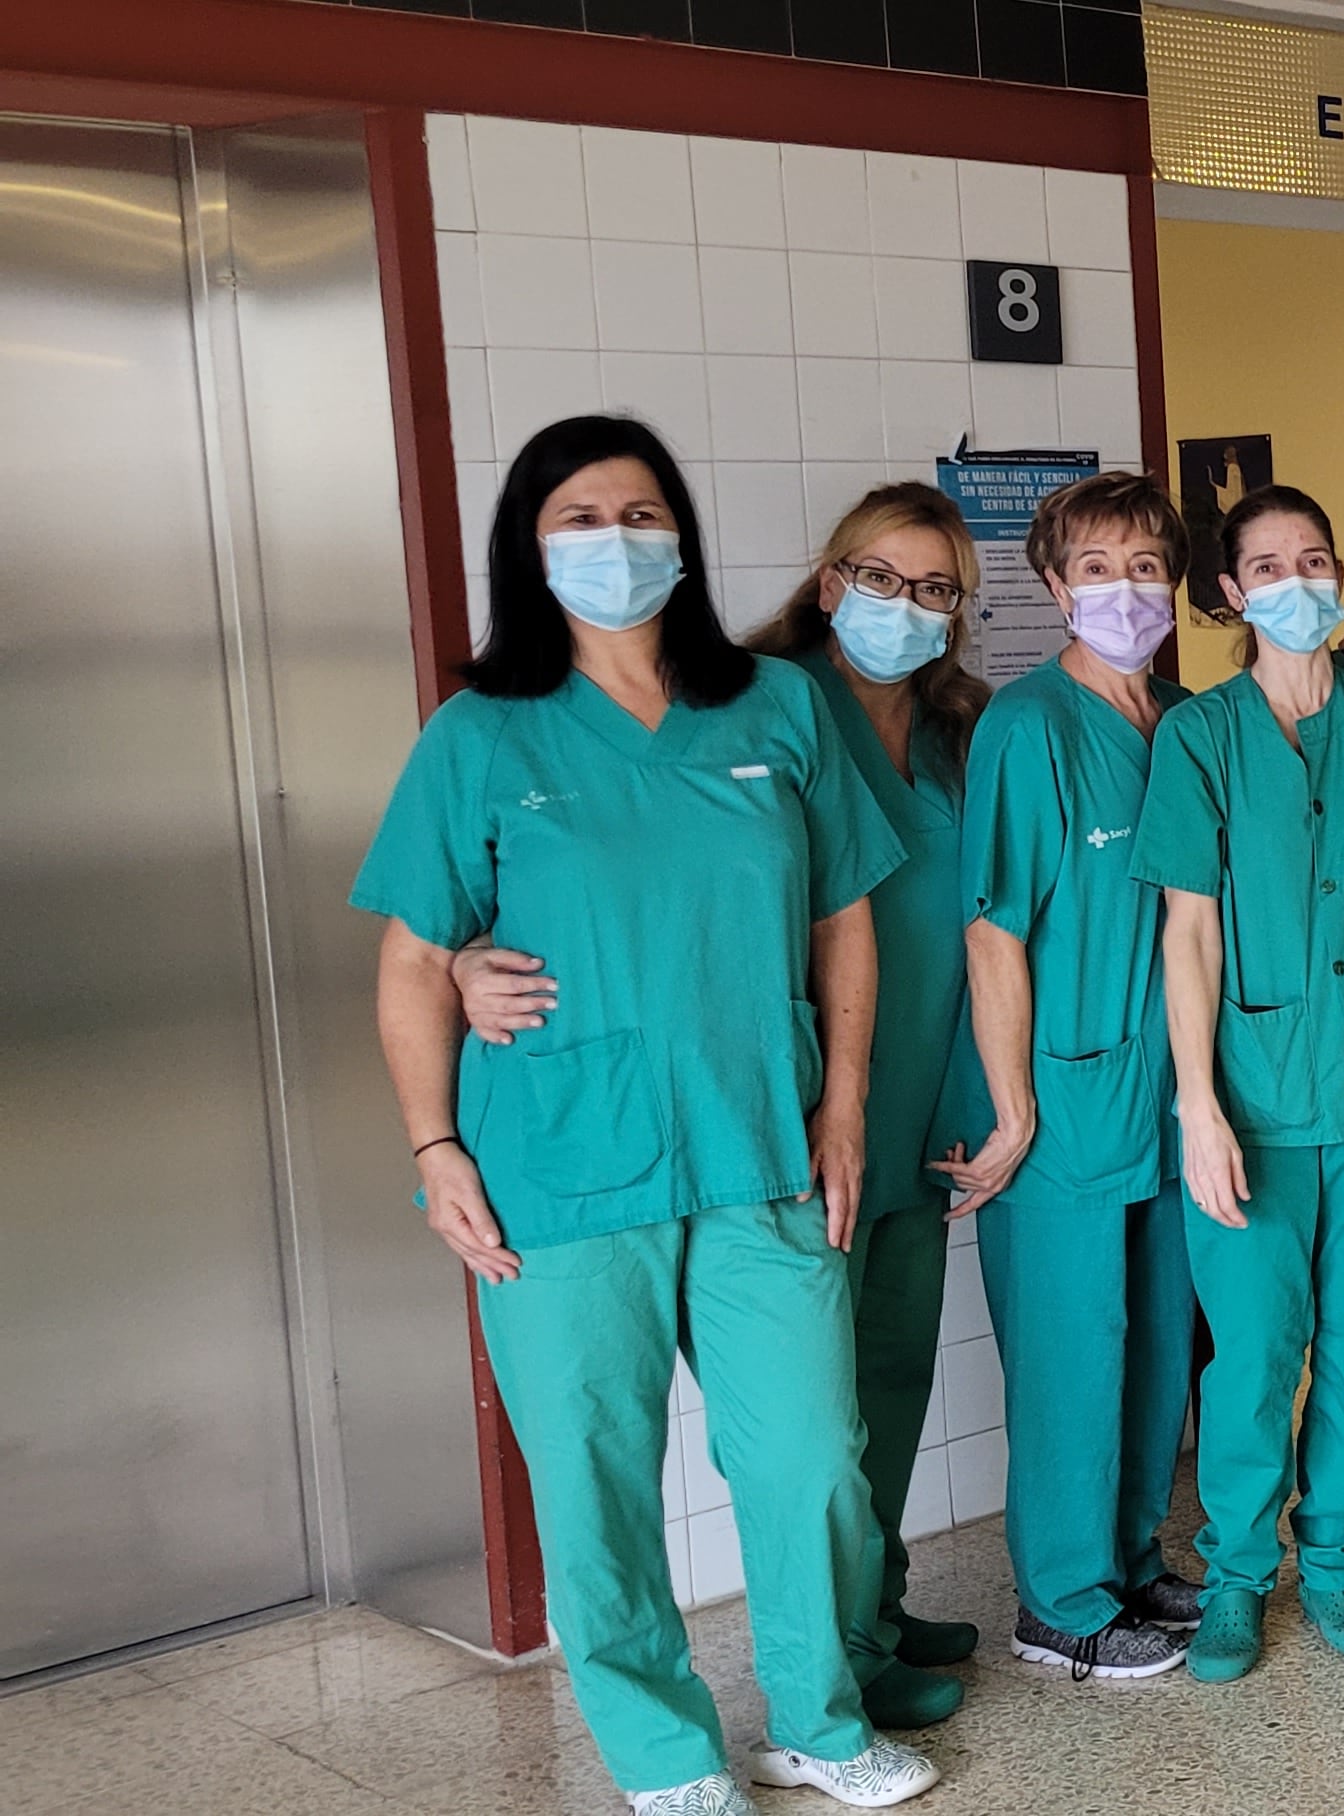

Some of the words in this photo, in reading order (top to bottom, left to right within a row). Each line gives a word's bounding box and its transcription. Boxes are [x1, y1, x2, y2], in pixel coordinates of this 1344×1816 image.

[998, 268, 1041, 333] 8
[957, 471, 969, 483] DE
[972, 471, 1007, 483] MANERA
[1033, 472, 1041, 483] Y
[960, 485, 975, 497] SIN
[977, 485, 1022, 497] NECESIDAD
[1024, 485, 1035, 497] DE
[982, 499, 1014, 511] CENTRO
[1015, 500, 1026, 511] DE
